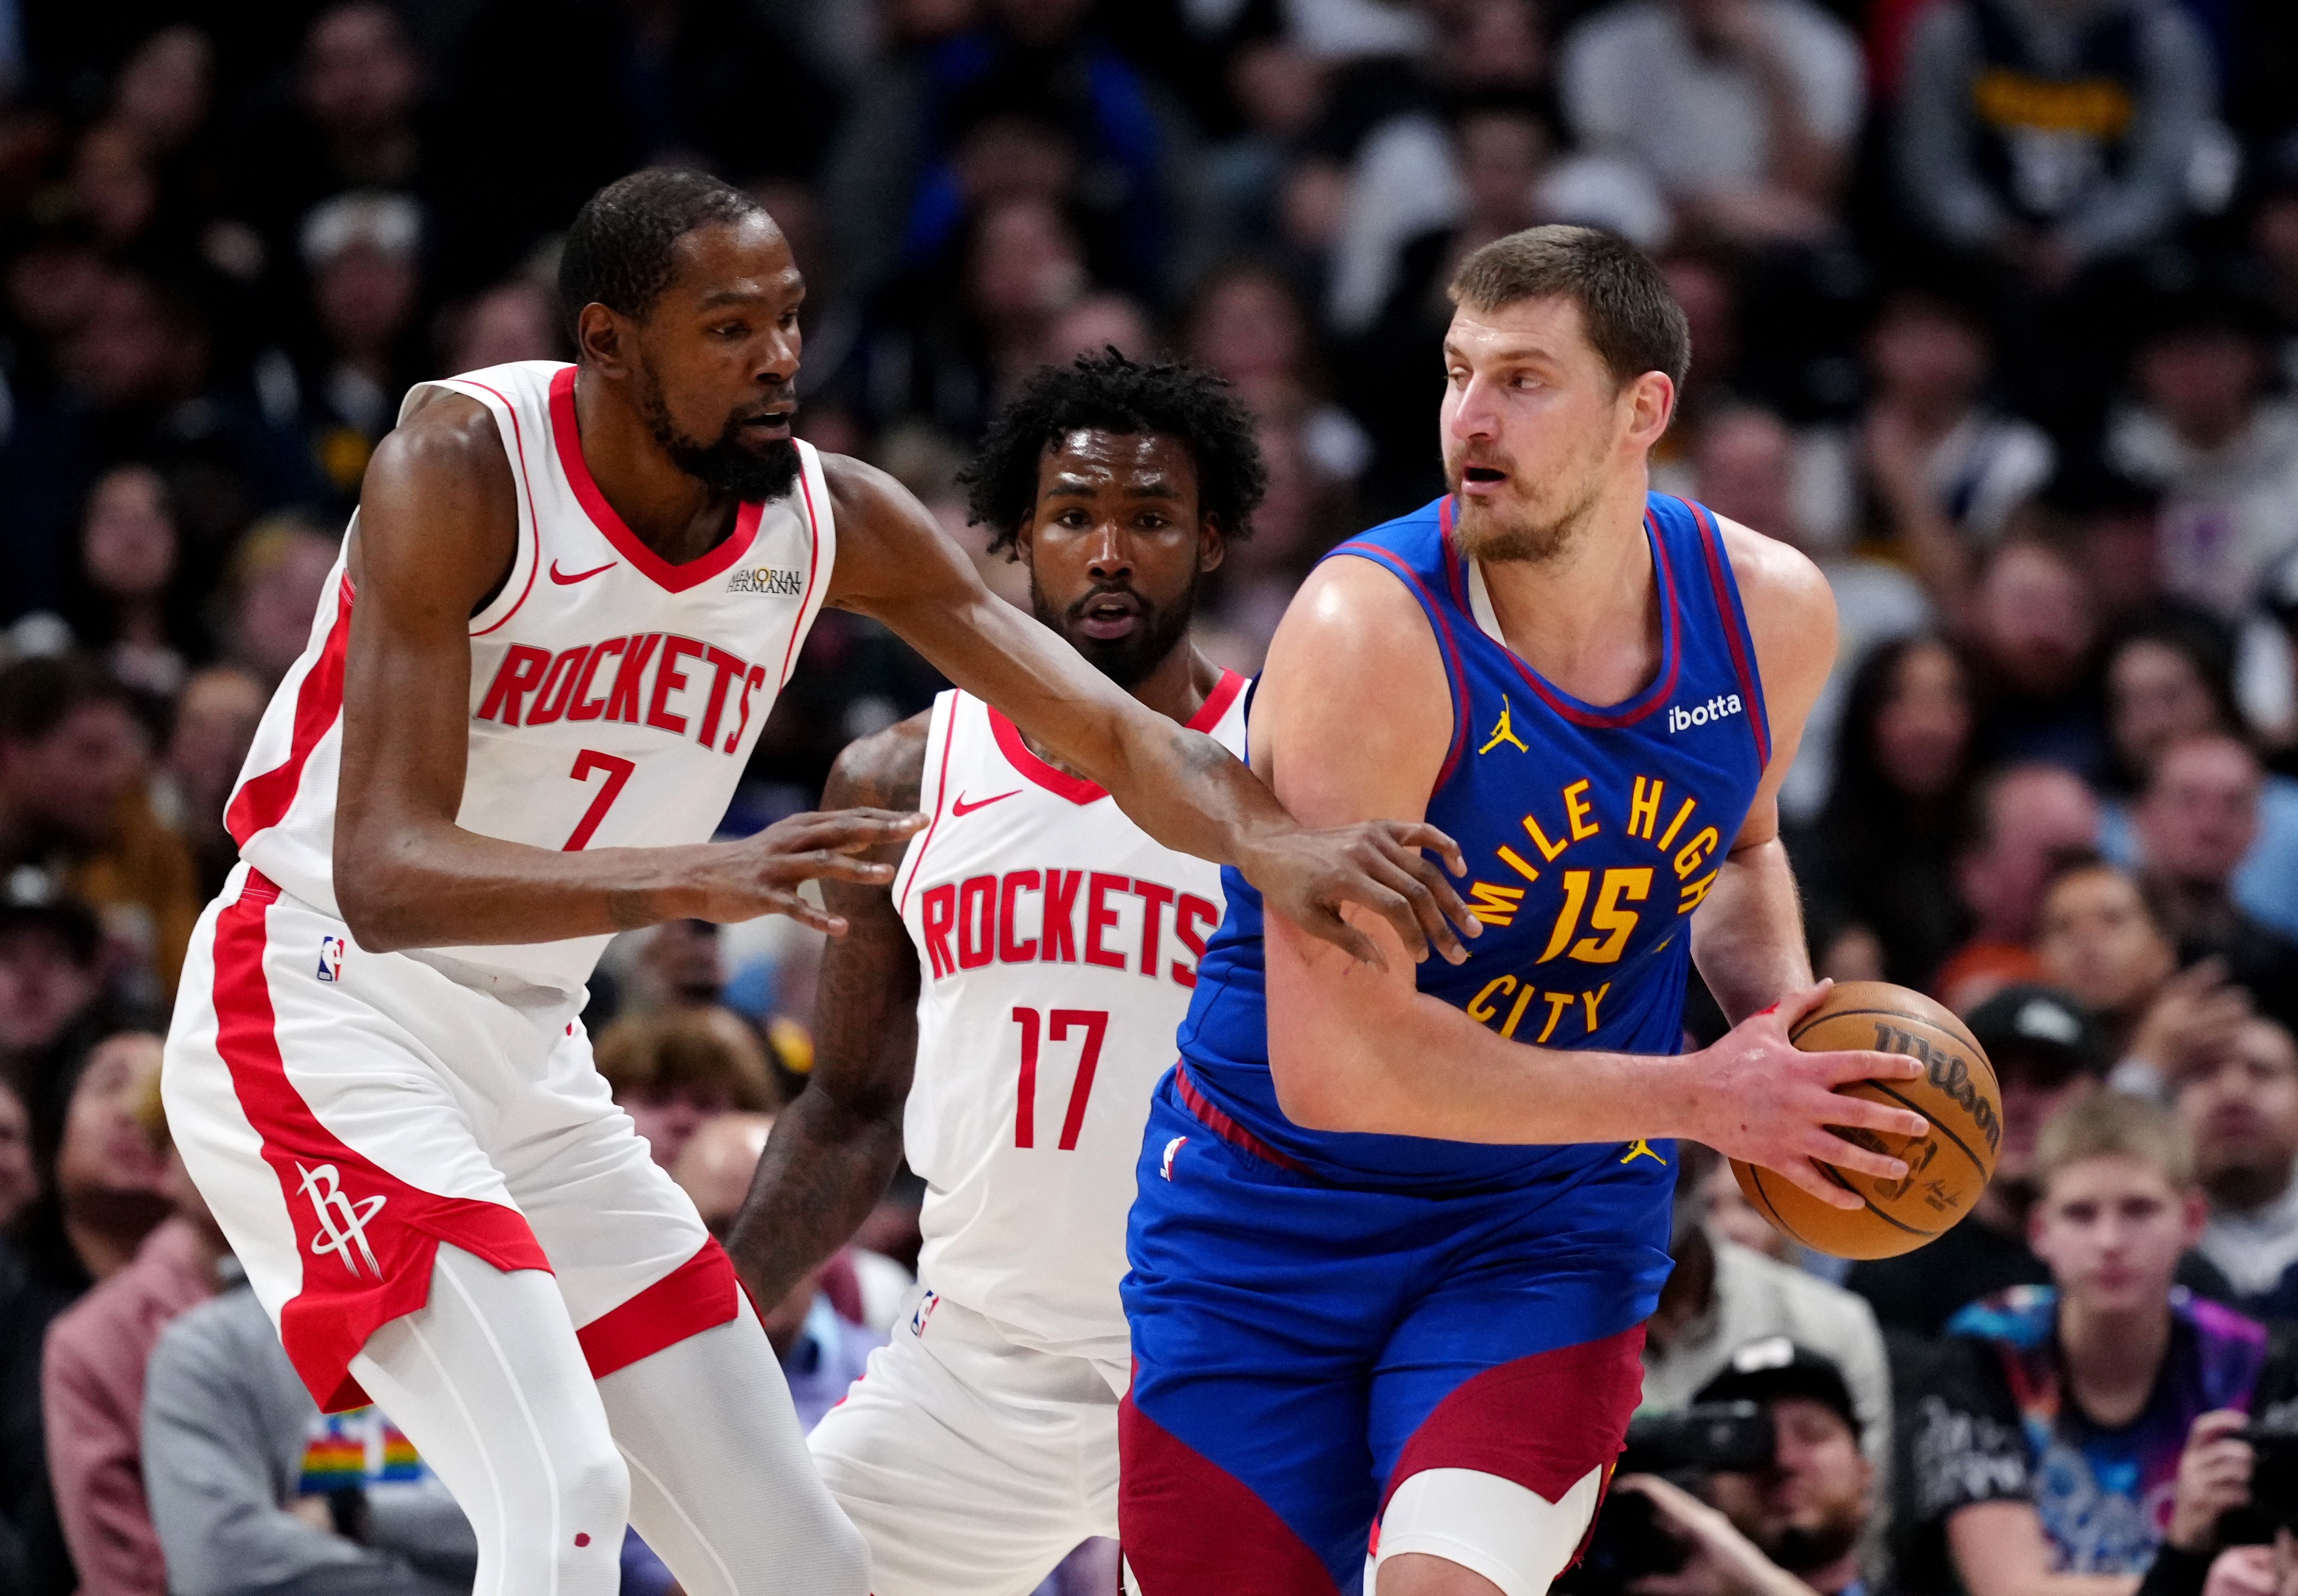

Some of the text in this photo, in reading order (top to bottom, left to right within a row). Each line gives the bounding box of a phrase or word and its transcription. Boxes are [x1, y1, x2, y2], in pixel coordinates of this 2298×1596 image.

[726, 580, 802, 595] HERMANN
[732, 569, 802, 584] MEMORIAL
[474, 632, 766, 756] ROCKETS
[1669, 694, 1742, 734] ibotta
[562, 749, 636, 852] 7
[1467, 778, 1600, 927] MILE
[922, 867, 1221, 991] ROCKETS
[1535, 867, 1655, 964] 15
[1467, 973, 1612, 1044] CITY
[1012, 1006, 1109, 1151] 17
